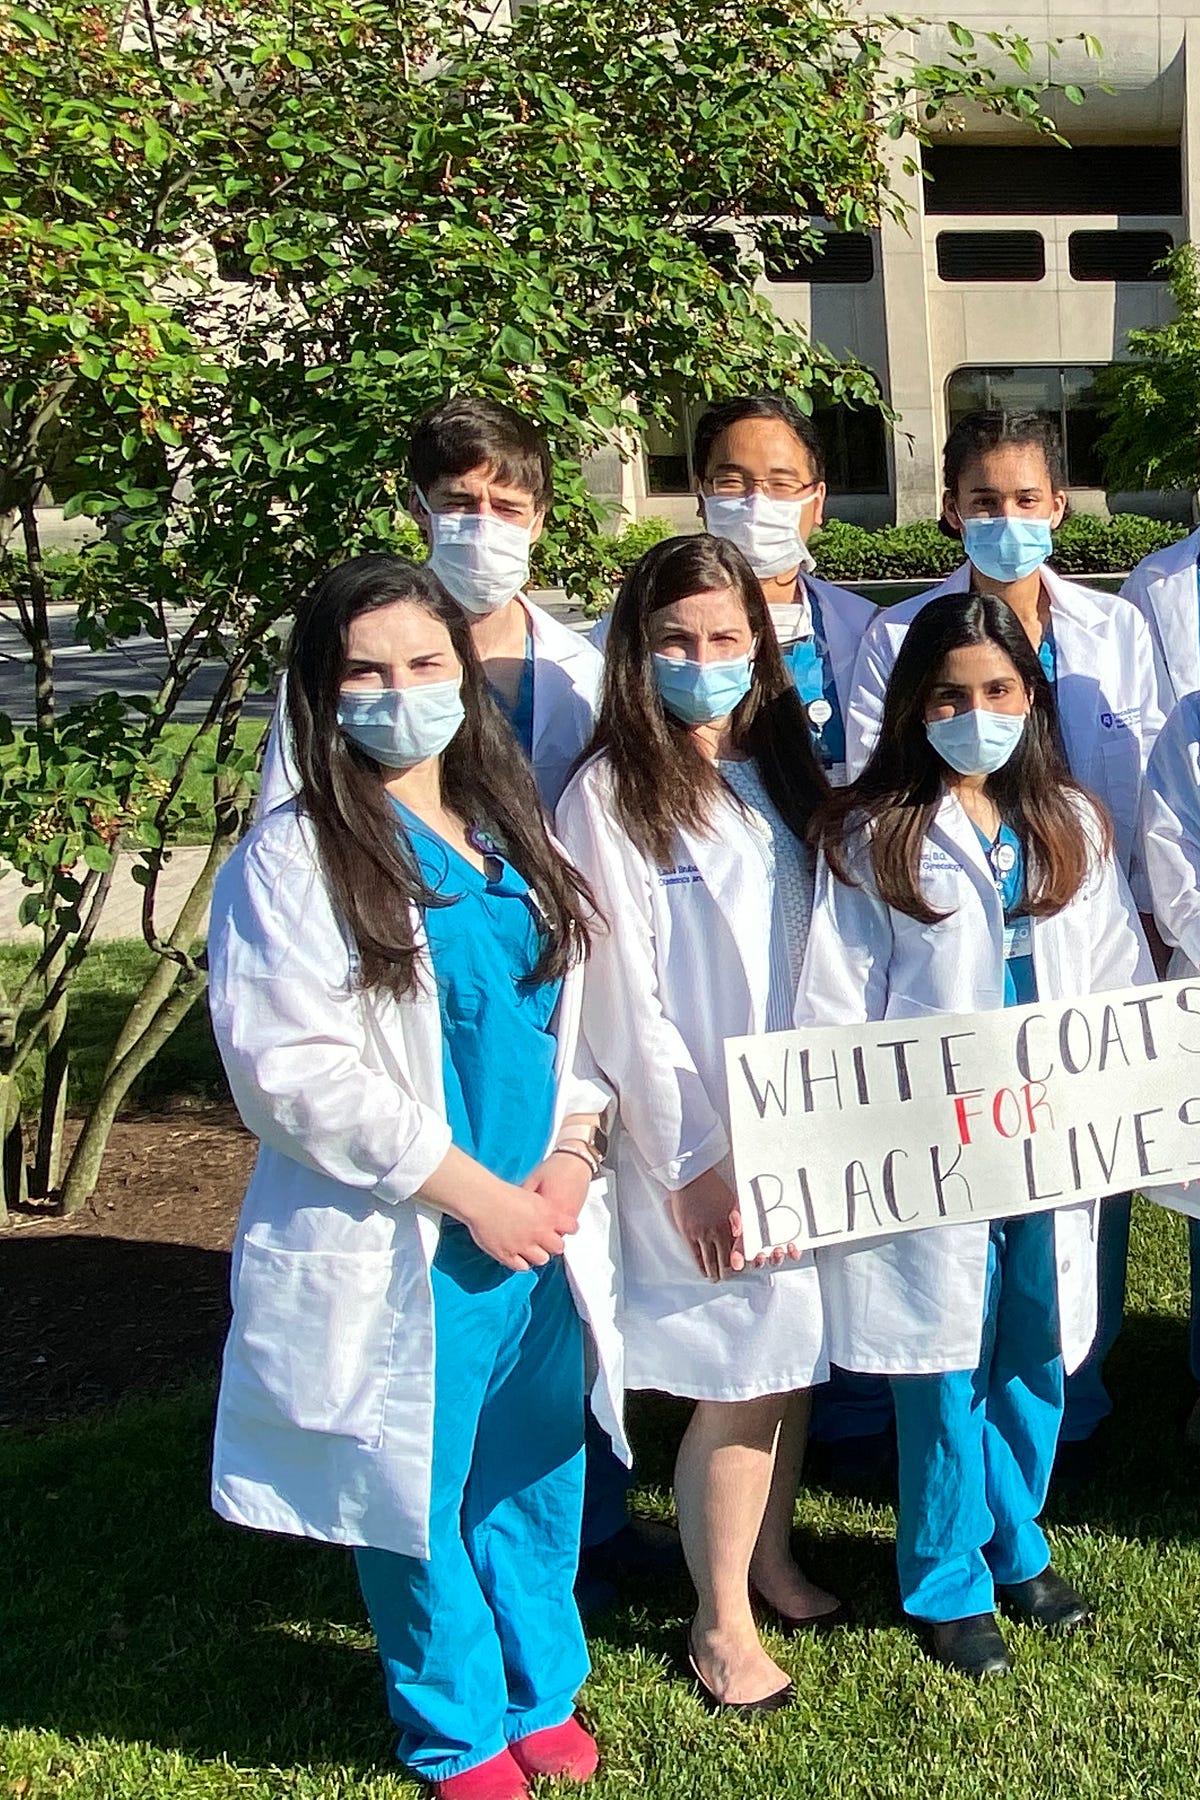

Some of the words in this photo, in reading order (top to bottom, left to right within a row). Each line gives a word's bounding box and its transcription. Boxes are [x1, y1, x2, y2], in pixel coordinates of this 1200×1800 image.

[738, 1031, 986, 1120] WHITE
[953, 1082, 1055, 1145] FOR
[748, 1144, 974, 1250] BLACK
